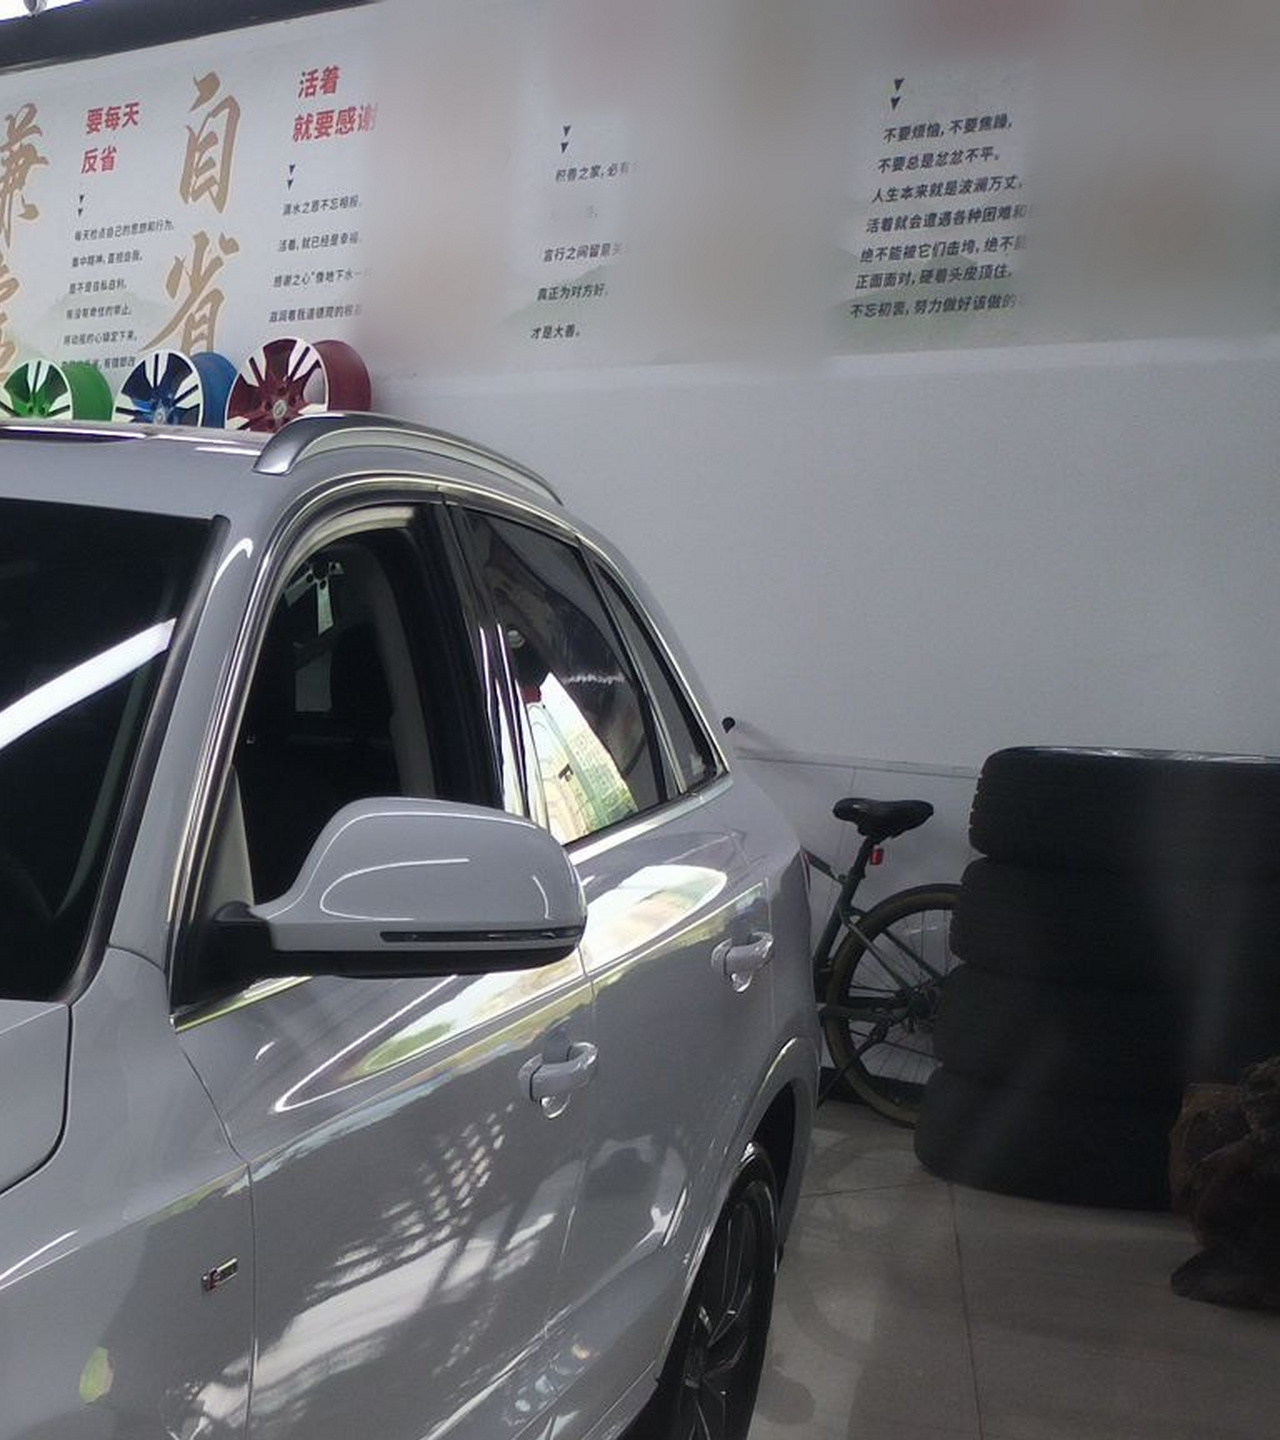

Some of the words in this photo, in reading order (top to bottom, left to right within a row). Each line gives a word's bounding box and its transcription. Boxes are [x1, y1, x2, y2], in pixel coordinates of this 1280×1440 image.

[298, 65, 340, 99] 活着
[86, 102, 140, 134] 要每天
[81, 146, 117, 174] 反省
[865, 203, 1034, 234] 活着就会遭遇各种困难和
